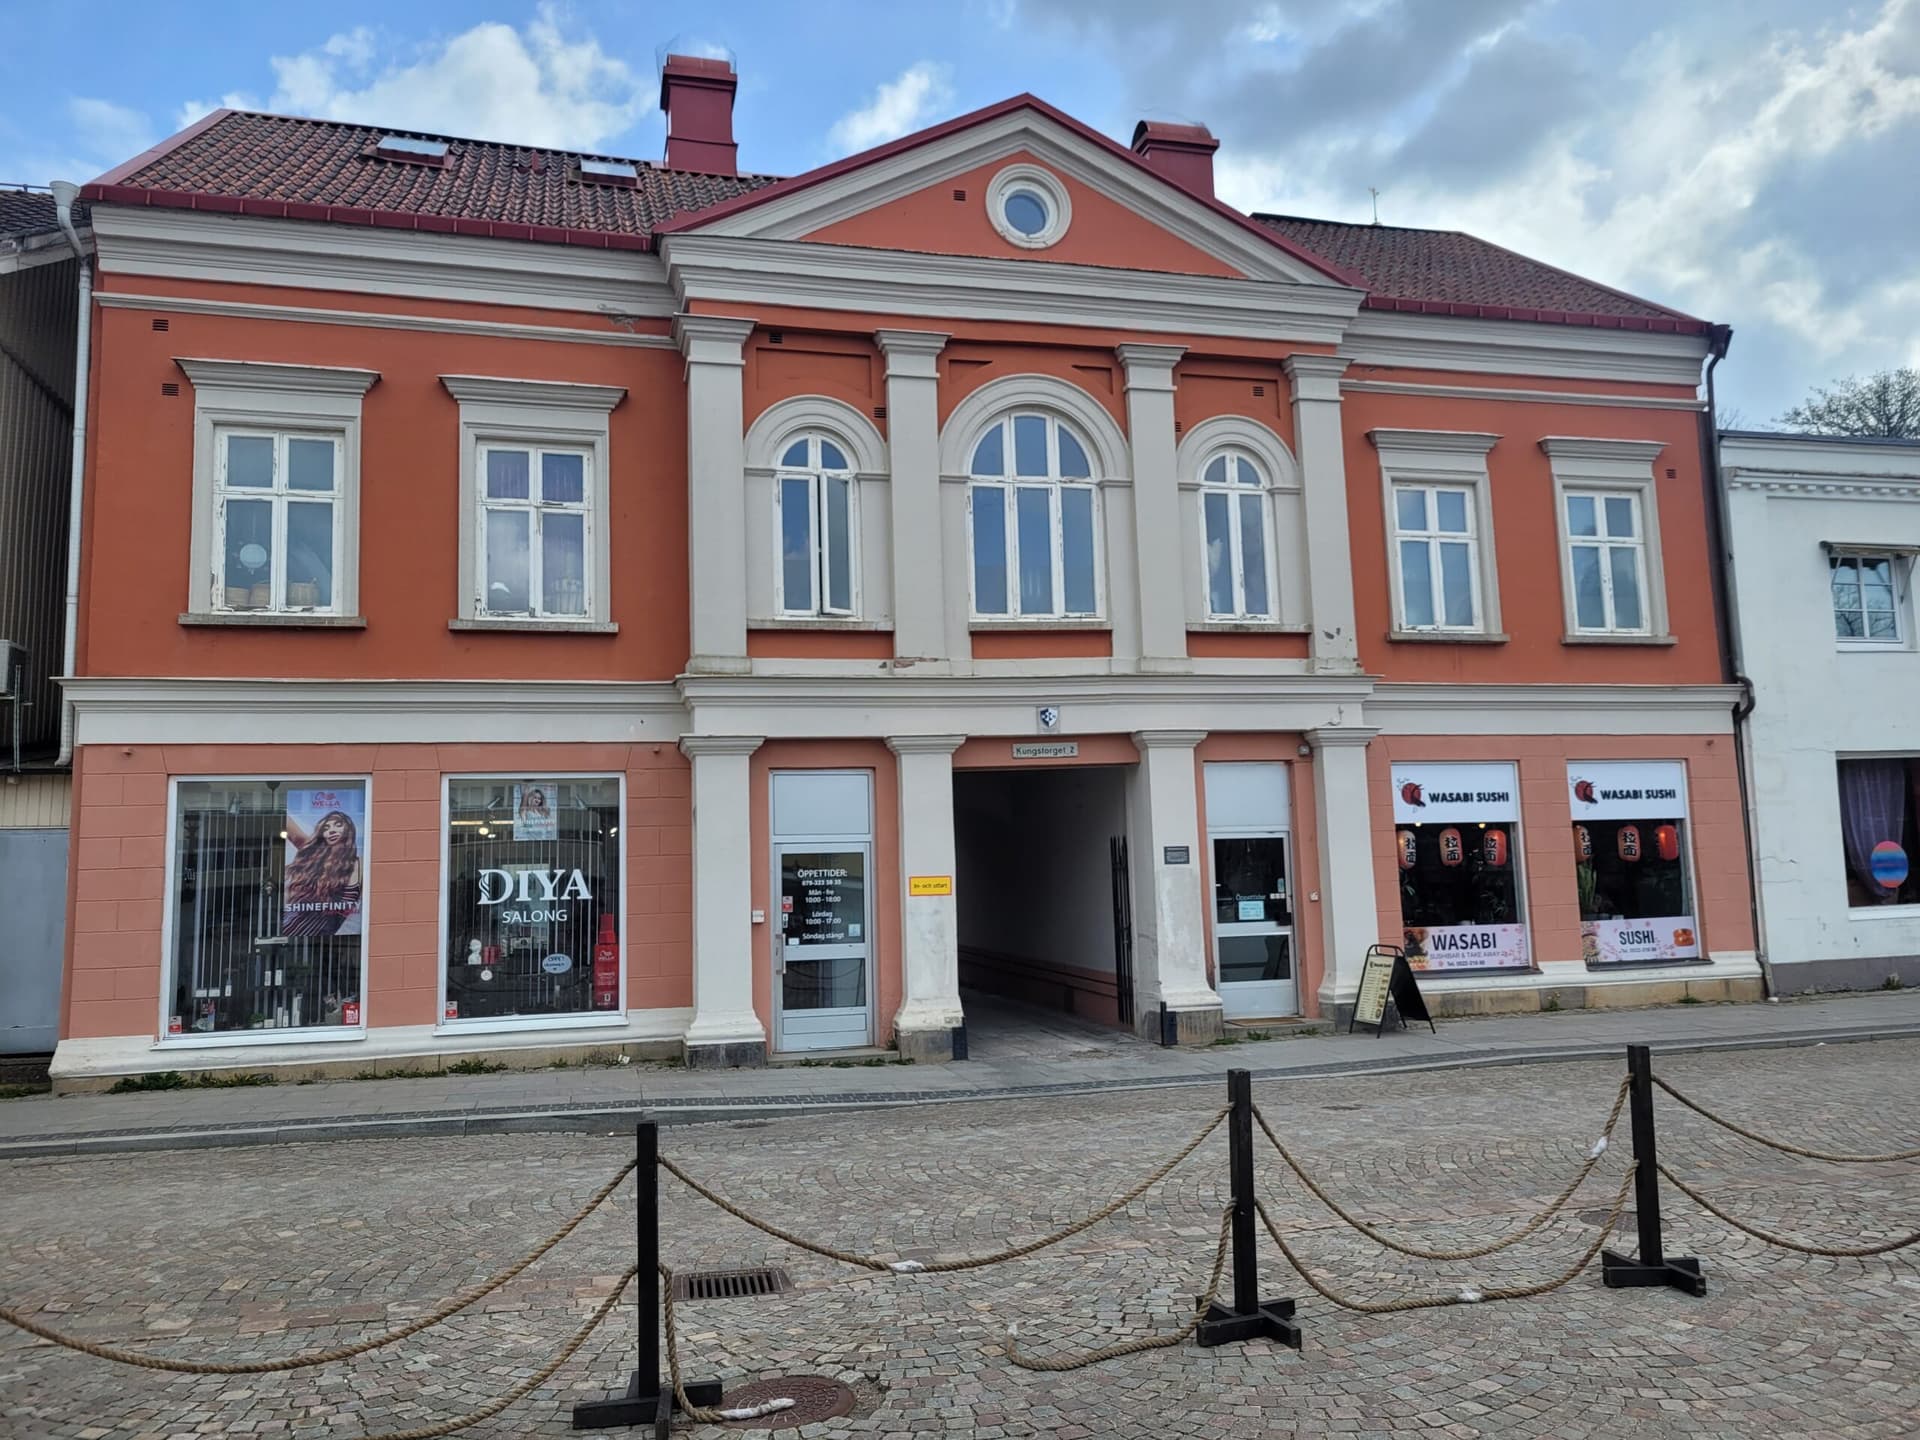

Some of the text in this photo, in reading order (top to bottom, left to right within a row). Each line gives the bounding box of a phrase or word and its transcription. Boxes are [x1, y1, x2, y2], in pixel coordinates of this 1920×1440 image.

[1015, 746, 1075, 757] Kungstorget 2
[1428, 791, 1510, 803] WASABI SUSHI
[1600, 789, 1676, 800] WASABI SUSHI
[797, 868, 848, 878] ÖPPETTIDER:
[476, 868, 594, 905] DIYA
[808, 888, 822, 896] Mån
[284, 901, 362, 912] SHINEFINITY
[501, 909, 568, 924] SALONG
[811, 911, 833, 919] Lördag
[802, 932, 845, 940] Söndag stängt
[1432, 932, 1497, 951] WASABI
[1618, 930, 1655, 945] SUSHI
